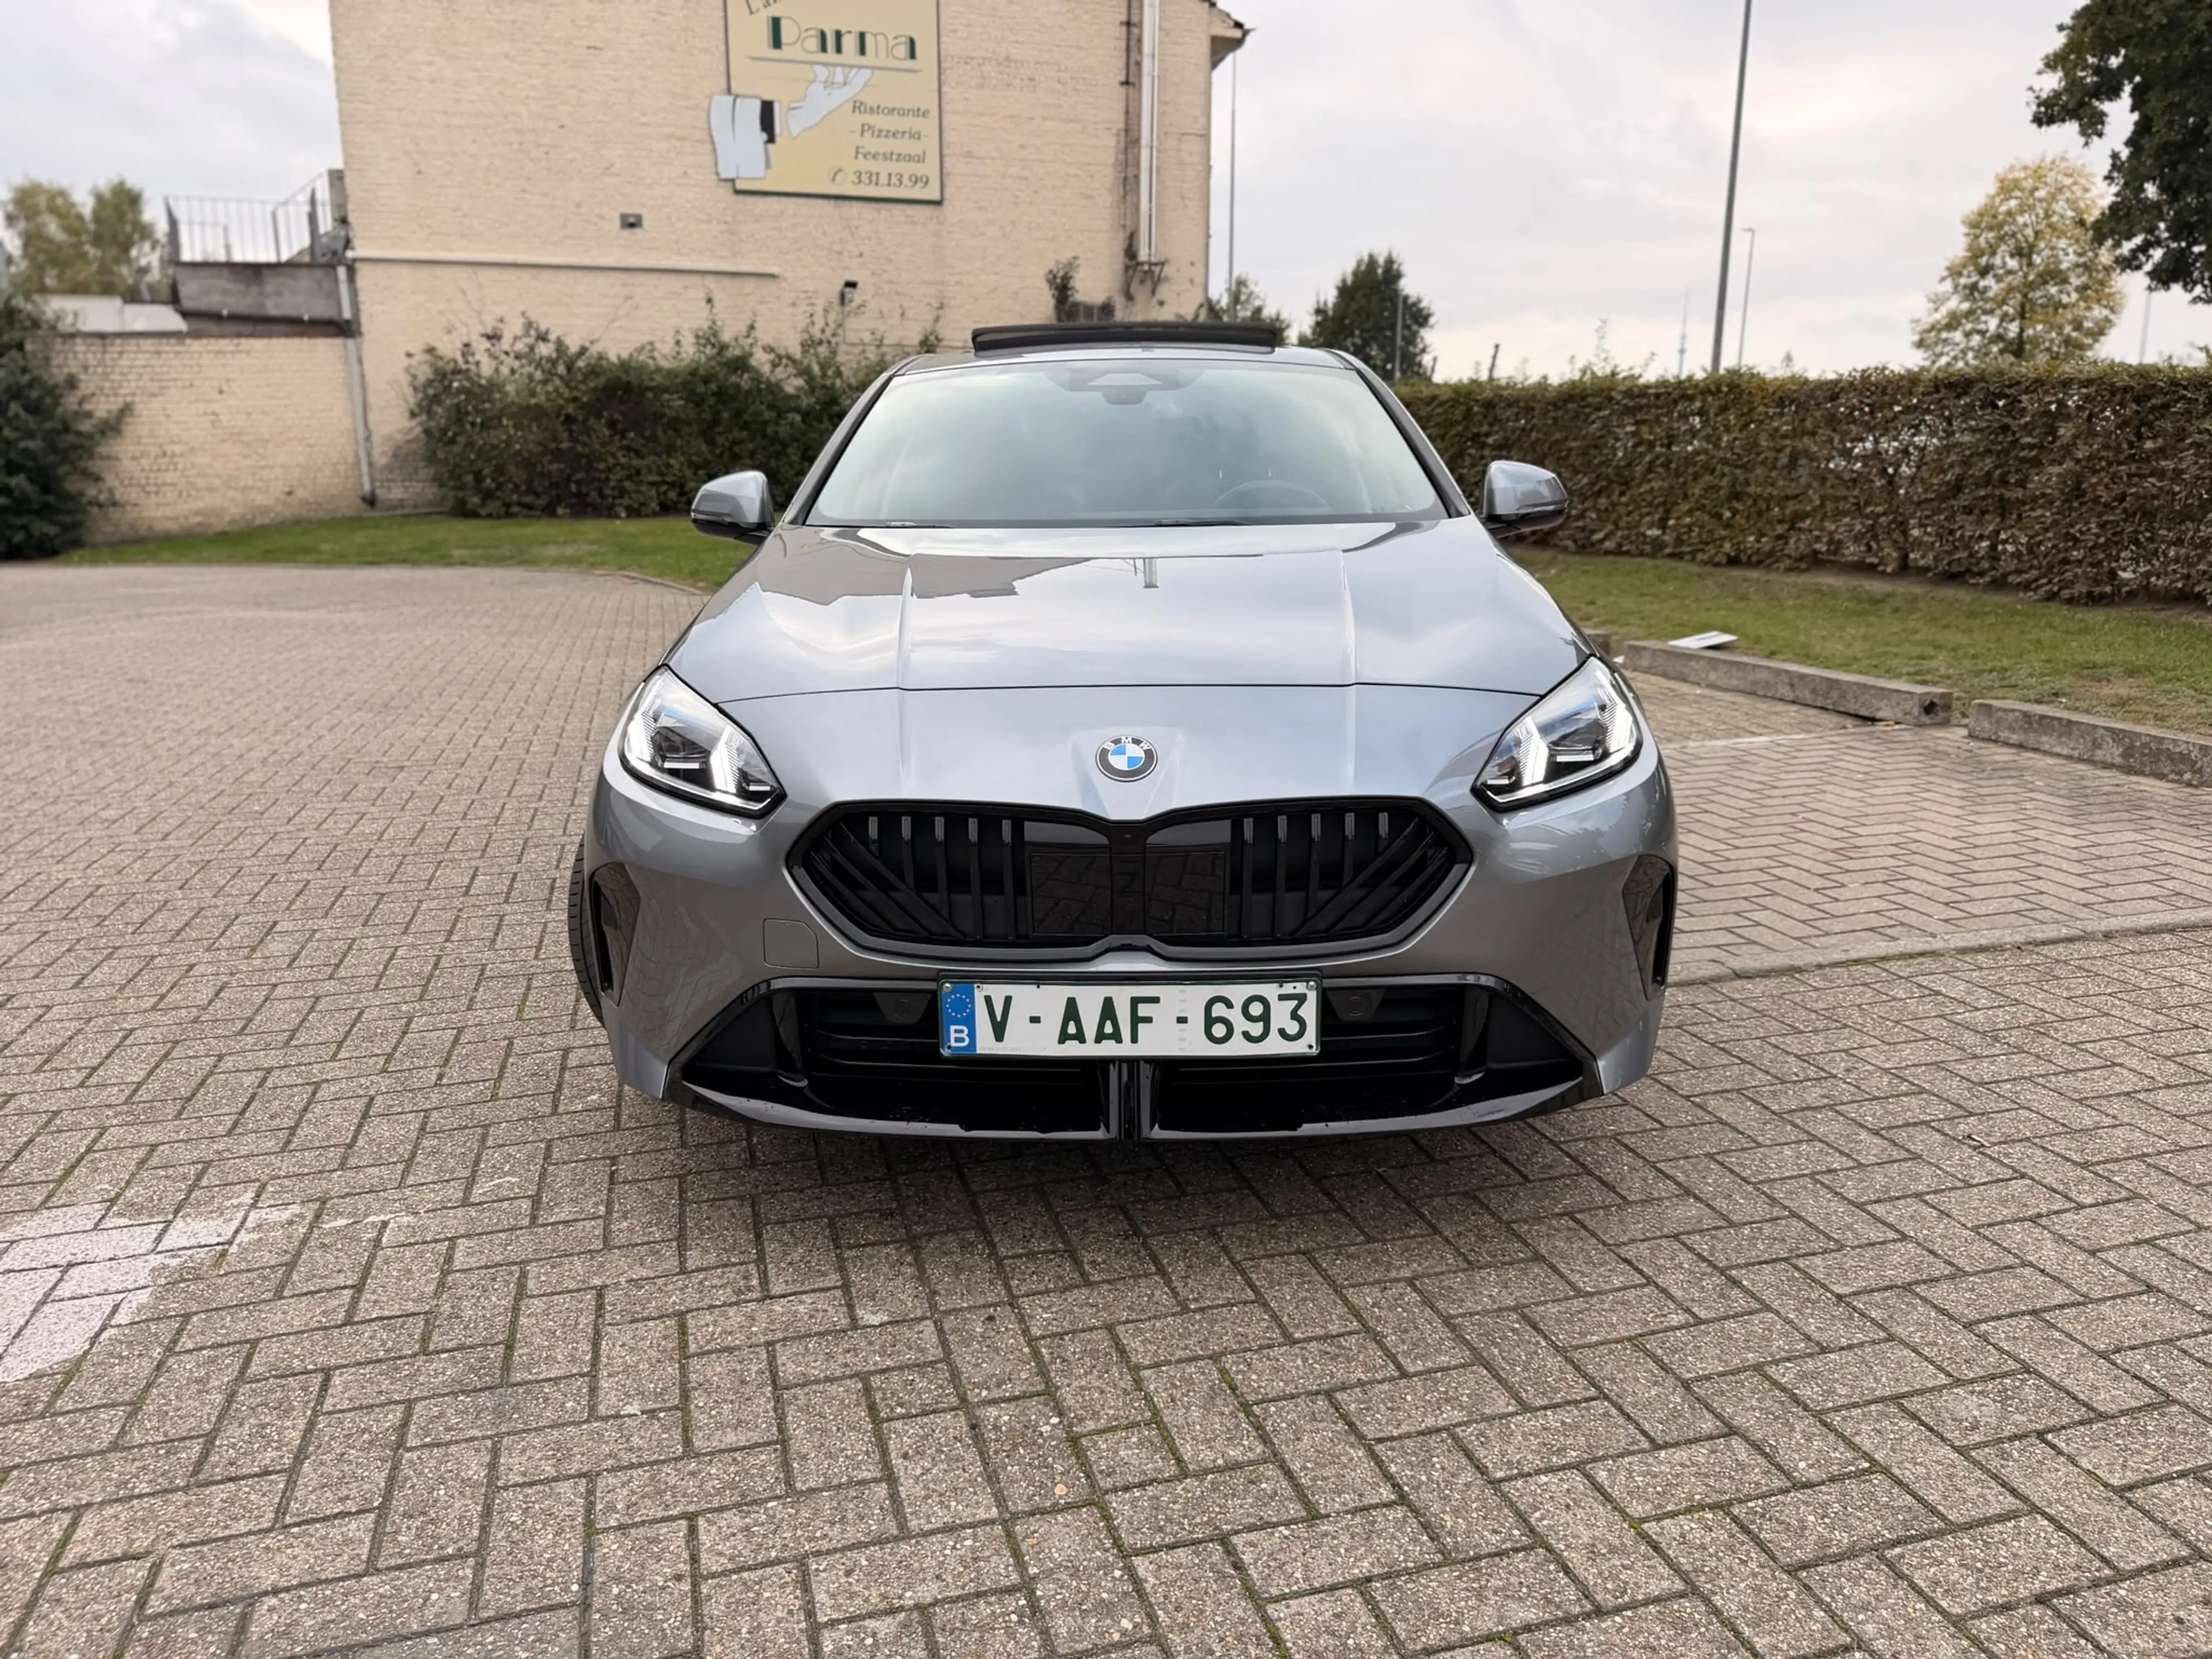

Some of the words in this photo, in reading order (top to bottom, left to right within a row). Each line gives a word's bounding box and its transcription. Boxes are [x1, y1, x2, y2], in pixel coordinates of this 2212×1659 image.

[767, 16, 916, 60] Parma
[852, 100, 930, 119] Ristorante
[854, 145, 926, 164] Feestzaal
[851, 169, 930, 189] 331.13.99
[1101, 737, 1152, 750] BMW
[950, 1026, 969, 1047] B
